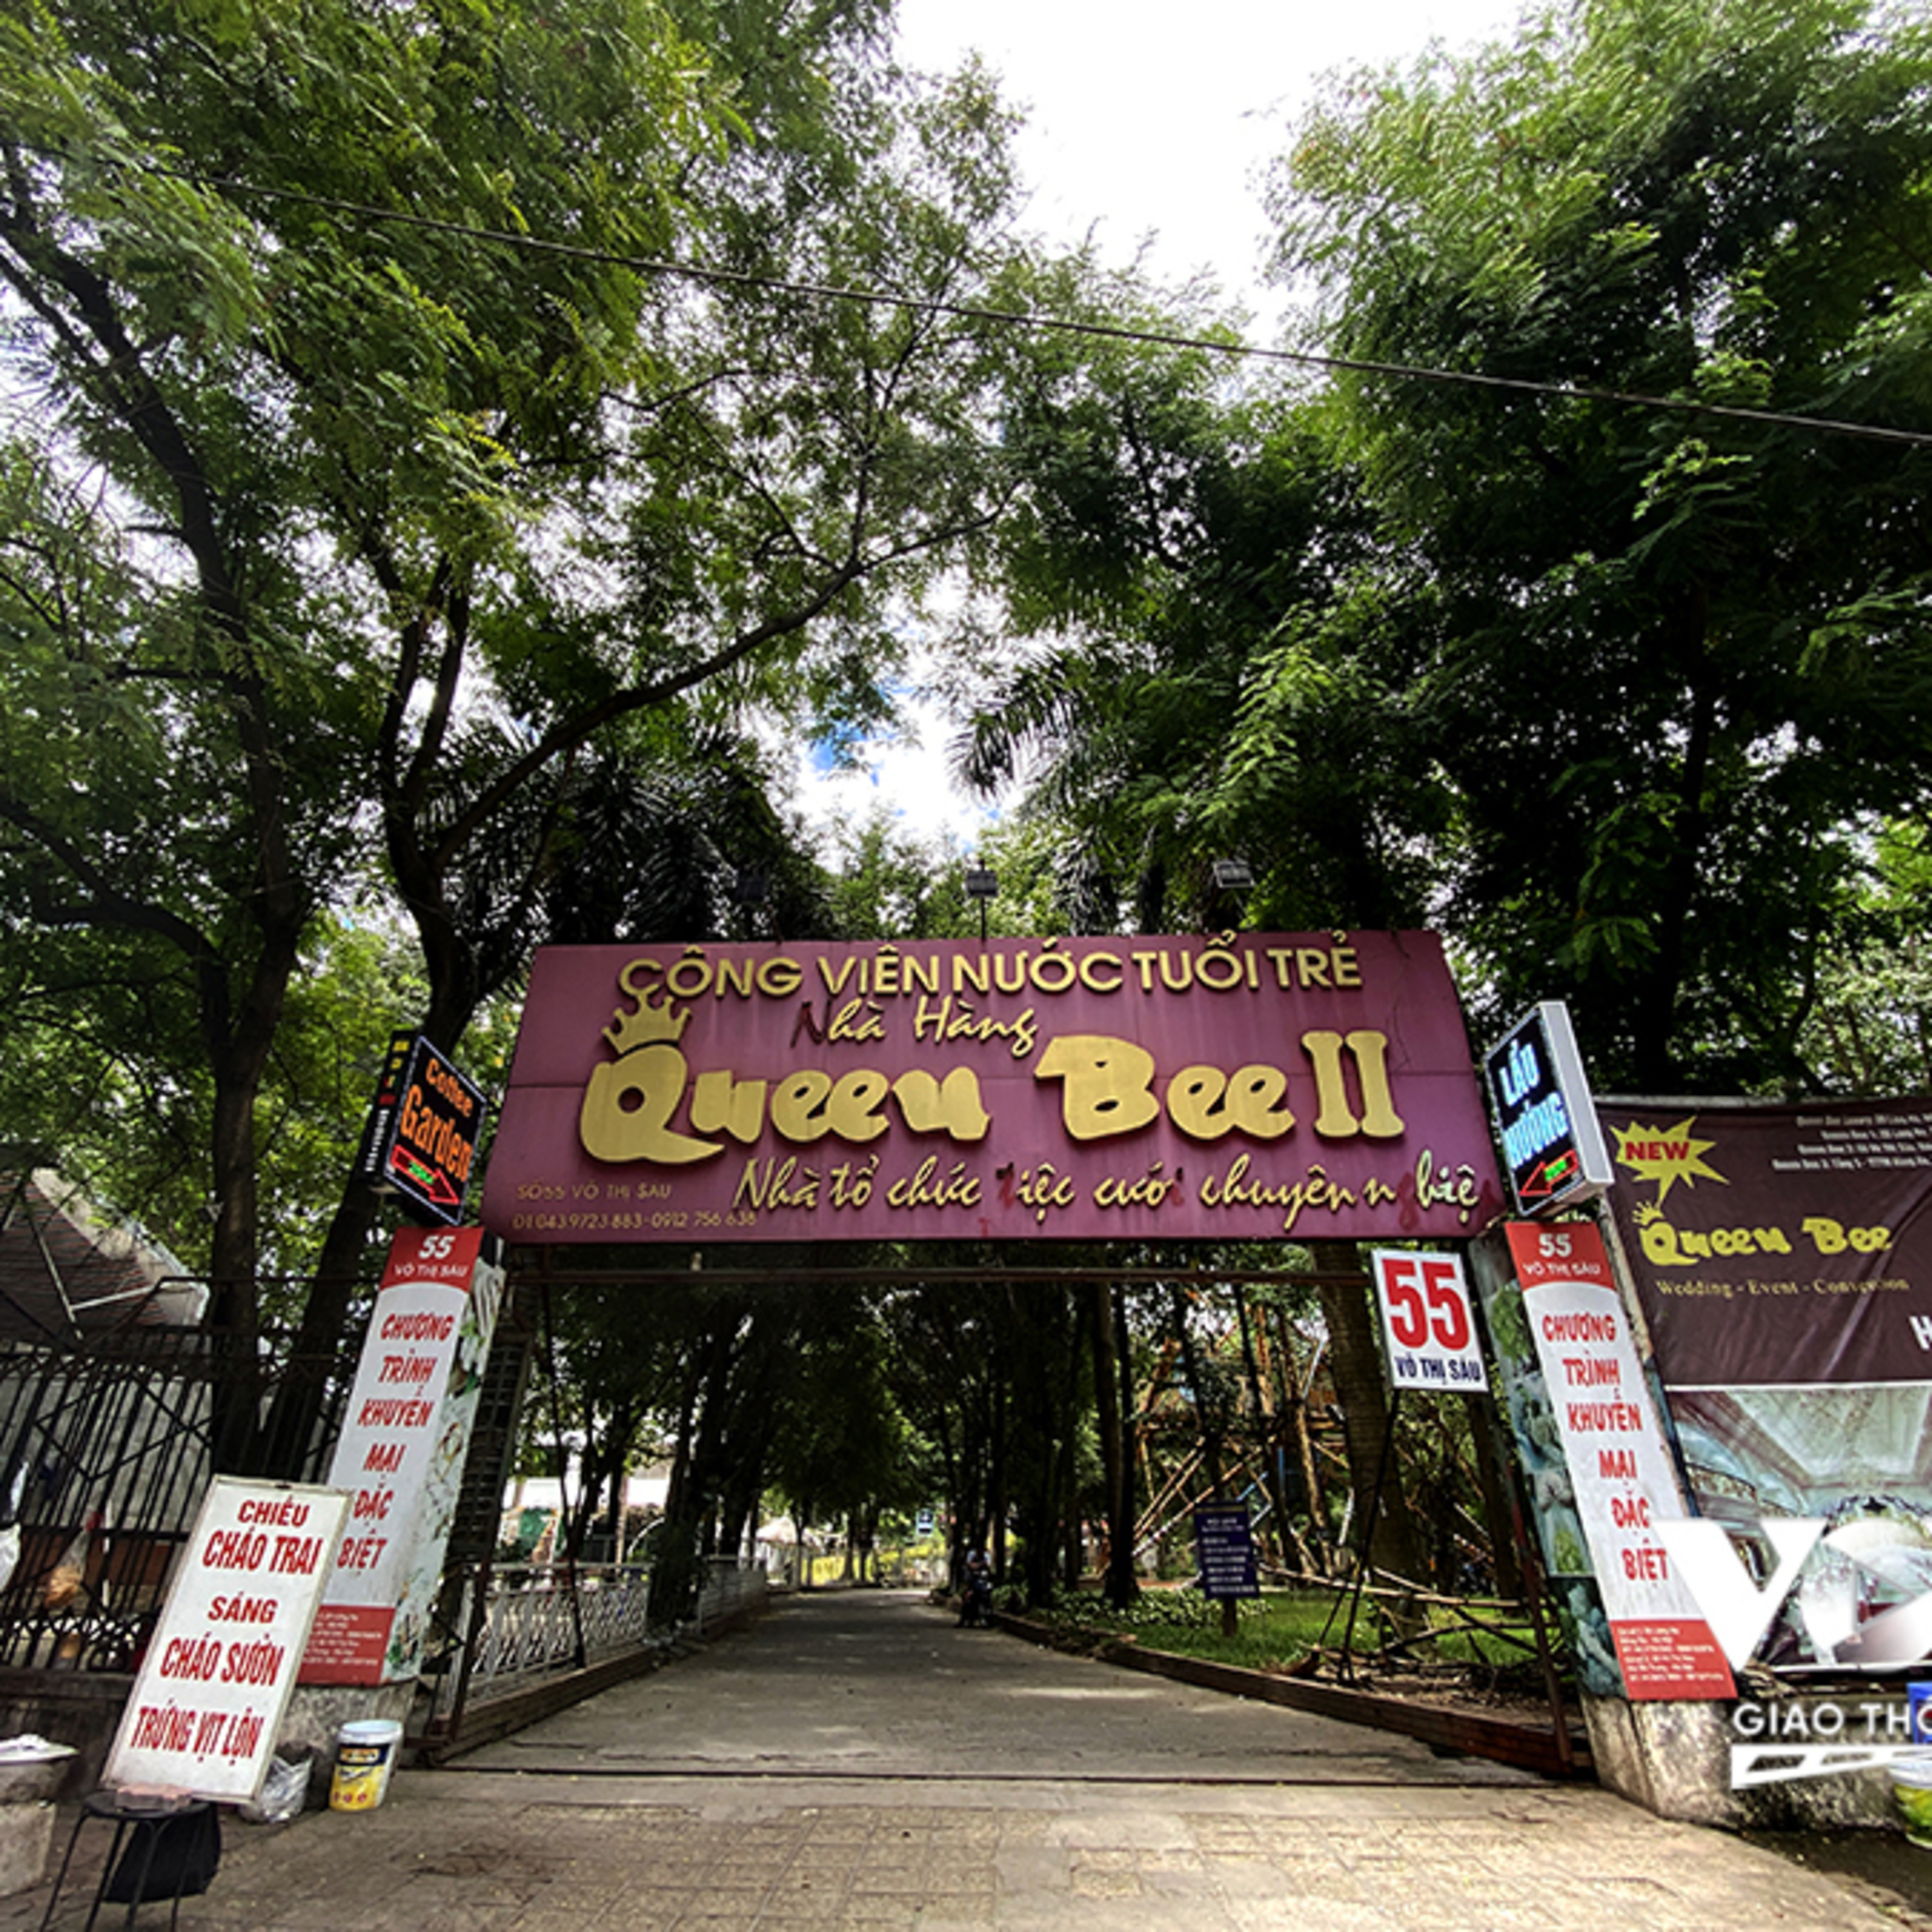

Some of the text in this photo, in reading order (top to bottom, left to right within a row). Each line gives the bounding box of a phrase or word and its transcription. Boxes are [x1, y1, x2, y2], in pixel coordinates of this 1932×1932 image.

[619, 929, 1362, 998] CÔNG VIÊN NƯỚC TUỔI TRẺ
[914, 995, 1038, 1059] Hàng
[580, 1030, 1405, 1164] Queen Bee II
[399, 1084, 473, 1183] Garden
[1625, 1141, 1690, 1160] NEW
[732, 1155, 821, 1209] Nhà
[829, 1153, 880, 1207] tổ
[886, 1155, 983, 1207] chức
[1199, 1152, 1357, 1231] chuyên
[419, 1235, 455, 1260] 55
[1539, 1233, 1573, 1257] 55
[1639, 1217, 1892, 1266] Queen Bee
[1381, 1258, 1470, 1351] 55
[1656, 1279, 1734, 1299] Wedding
[1747, 1279, 1799, 1296] Event
[203, 1525, 324, 1575] CHÁO TRAI
[207, 1591, 279, 1625] SÁNG
[159, 1631, 222, 1683] CHÁO
